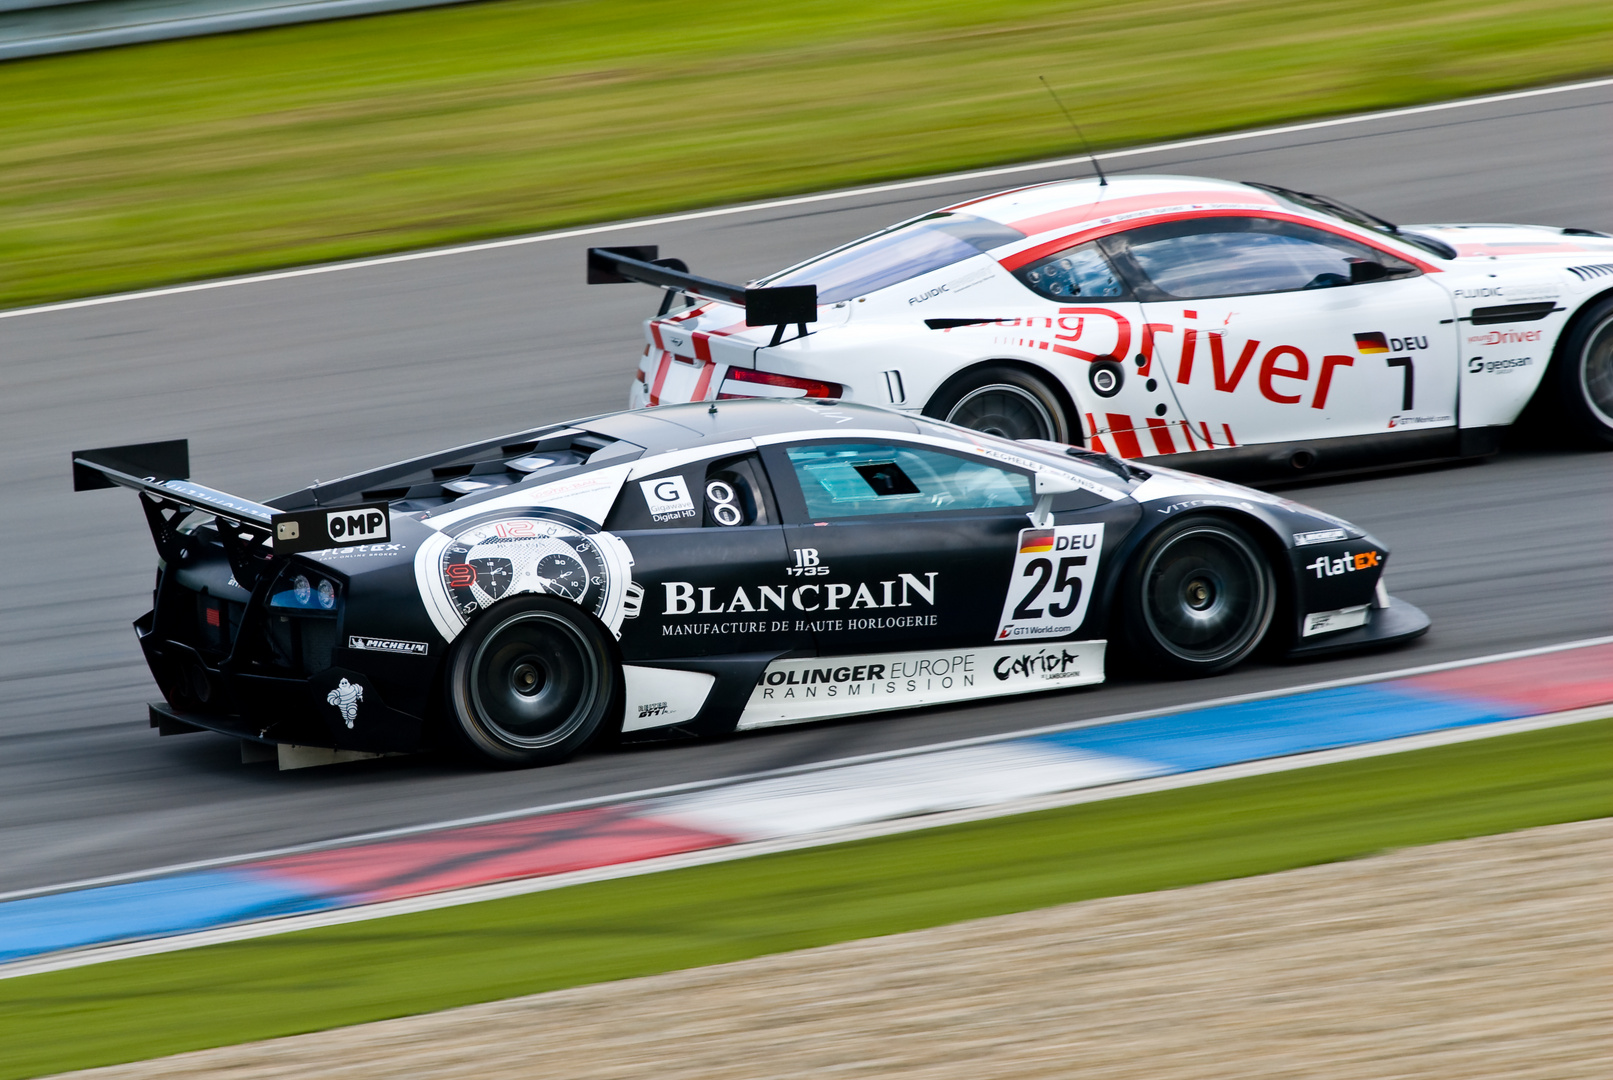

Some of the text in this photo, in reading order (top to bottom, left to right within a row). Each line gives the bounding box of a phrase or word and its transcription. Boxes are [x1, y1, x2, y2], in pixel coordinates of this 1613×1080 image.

[908, 283, 950, 306] FLUIDIC
[1389, 335, 1429, 352] DEU
[1486, 357, 1533, 373] geosan
[654, 481, 681, 502] G
[650, 501, 693, 513] Gigawave
[653, 509, 697, 523] Digital HD
[329, 512, 384, 539] OMP
[1055, 533, 1097, 551] DEU
[339, 552, 367, 560] ONLINE
[785, 565, 831, 577] 1735
[660, 571, 939, 615] BLANCPAIN
[1011, 555, 1088, 620] 25
[661, 614, 939, 636] MANUFACTURE DE HAUTE HORLOGERIE
[366, 640, 426, 652] MICHELIN
[890, 654, 976, 679] EUROPE
